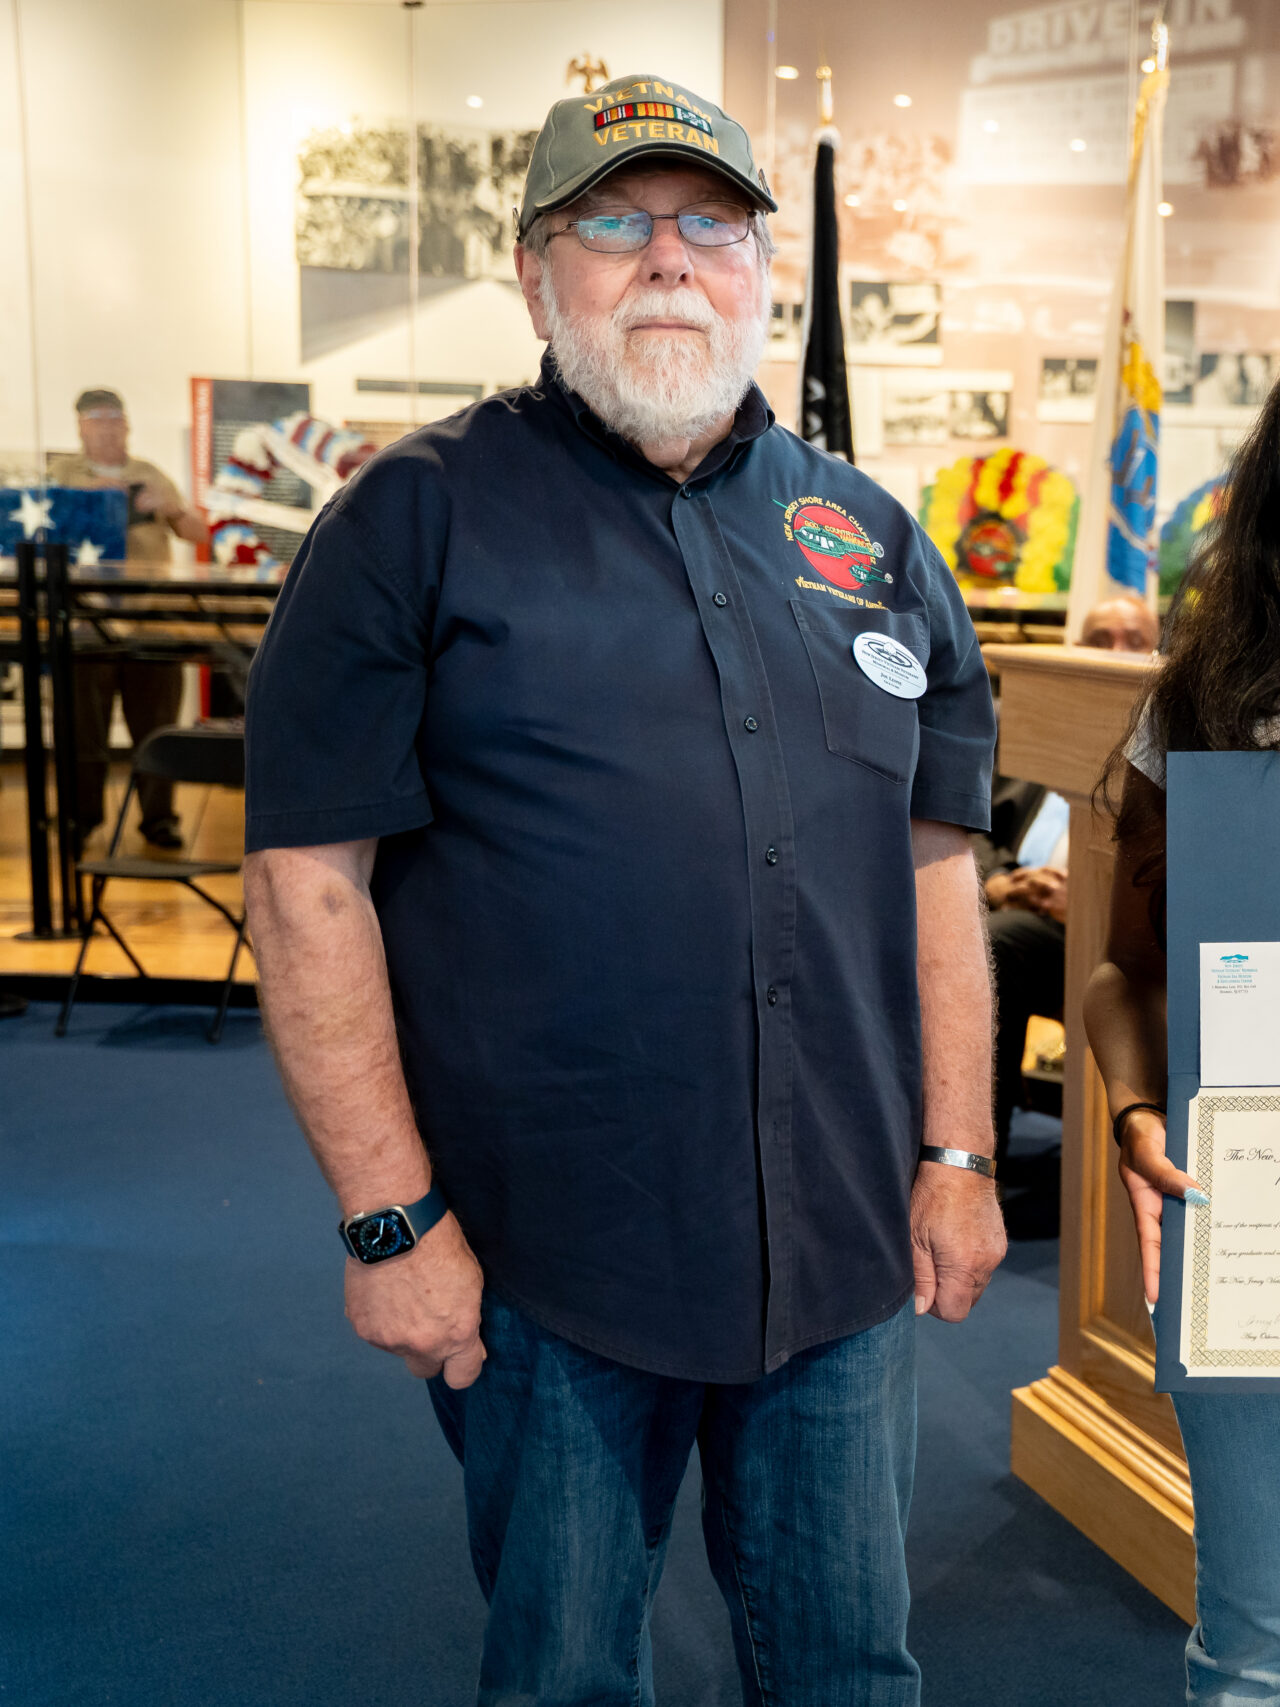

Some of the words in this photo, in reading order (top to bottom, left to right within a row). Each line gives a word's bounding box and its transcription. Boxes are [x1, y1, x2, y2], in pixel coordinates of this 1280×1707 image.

[584, 81, 712, 124] VIETNAM
[592, 121, 719, 154] VETERAN
[784, 523, 794, 542] NEW
[798, 496, 824, 505] SHORE
[825, 500, 847, 516] AREA
[795, 575, 827, 592] VIETNAM
[826, 585, 856, 603] VETERANS
[1224, 1149, 1246, 1162] The
[1247, 1148, 1274, 1161] New
